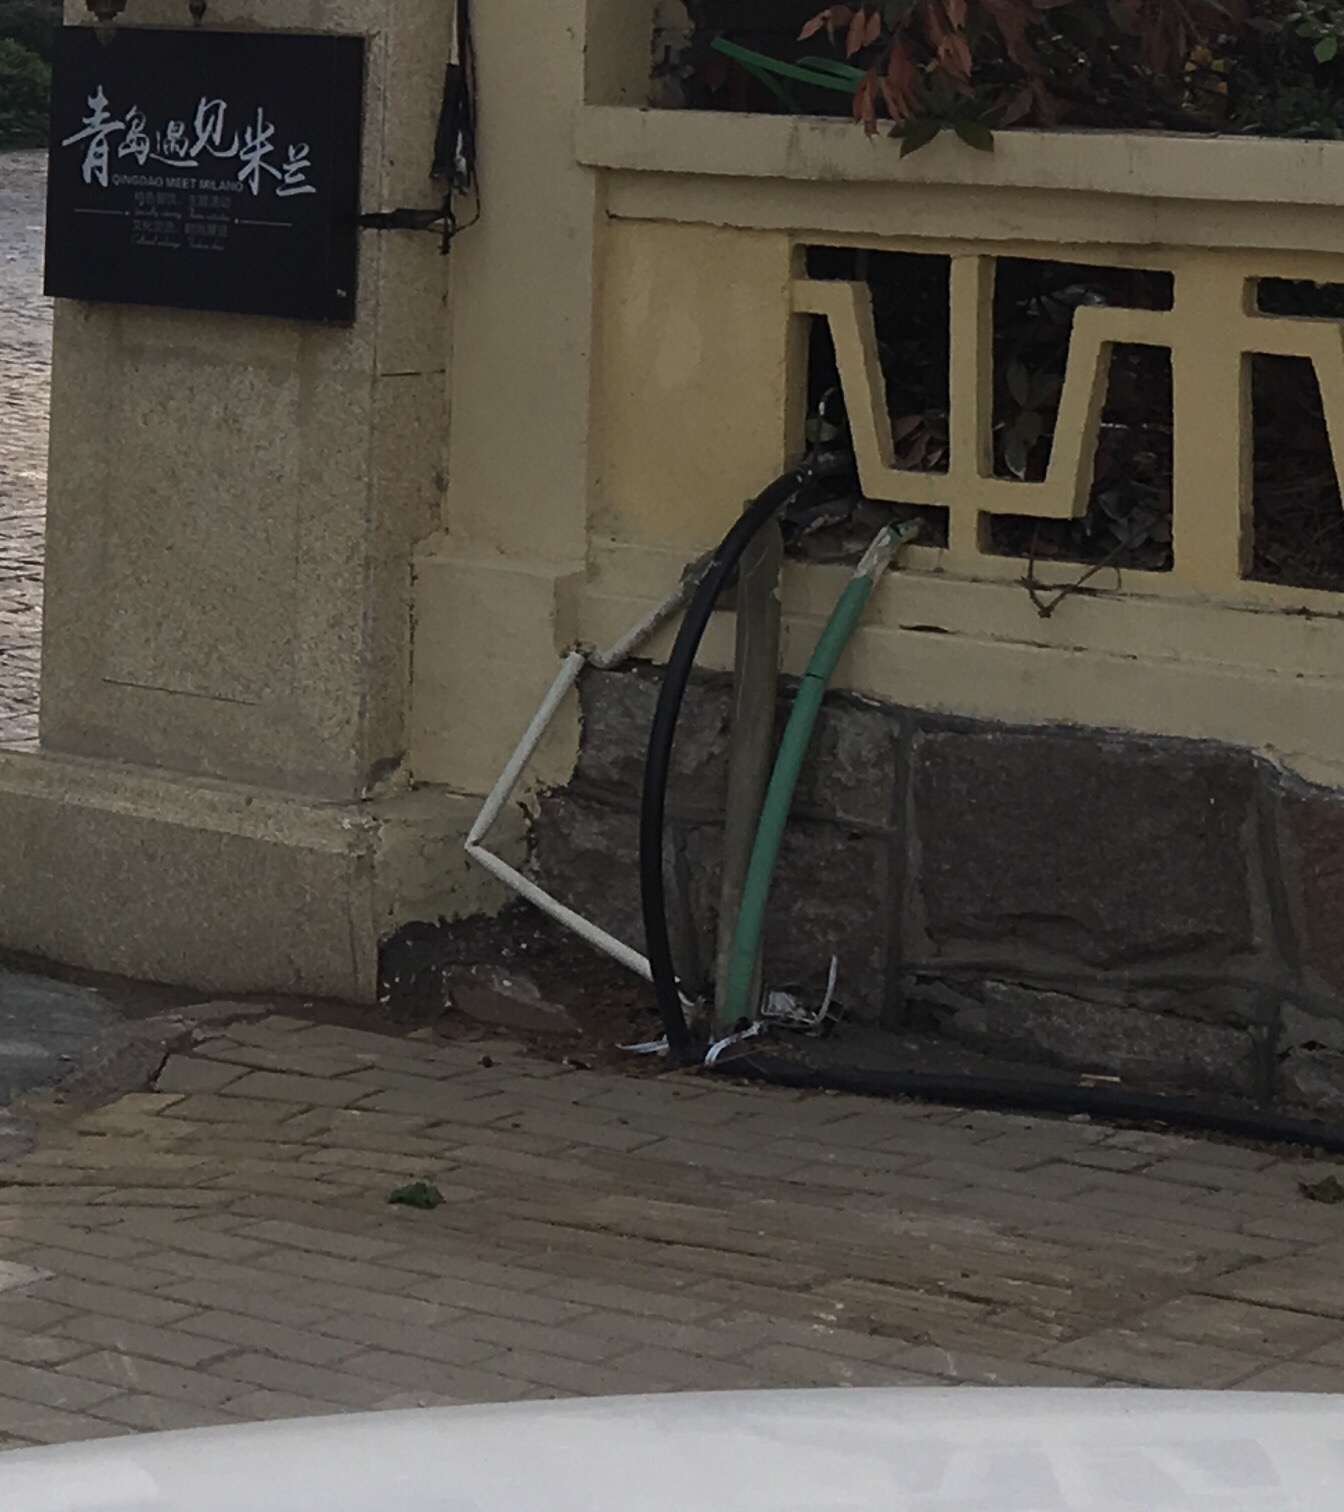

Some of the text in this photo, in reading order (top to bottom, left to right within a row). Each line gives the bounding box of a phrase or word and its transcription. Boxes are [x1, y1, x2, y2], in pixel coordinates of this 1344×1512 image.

[61, 84, 317, 198] 青岛遇见米兰
[112, 173, 244, 193] QINGDAO MEET MILANO
